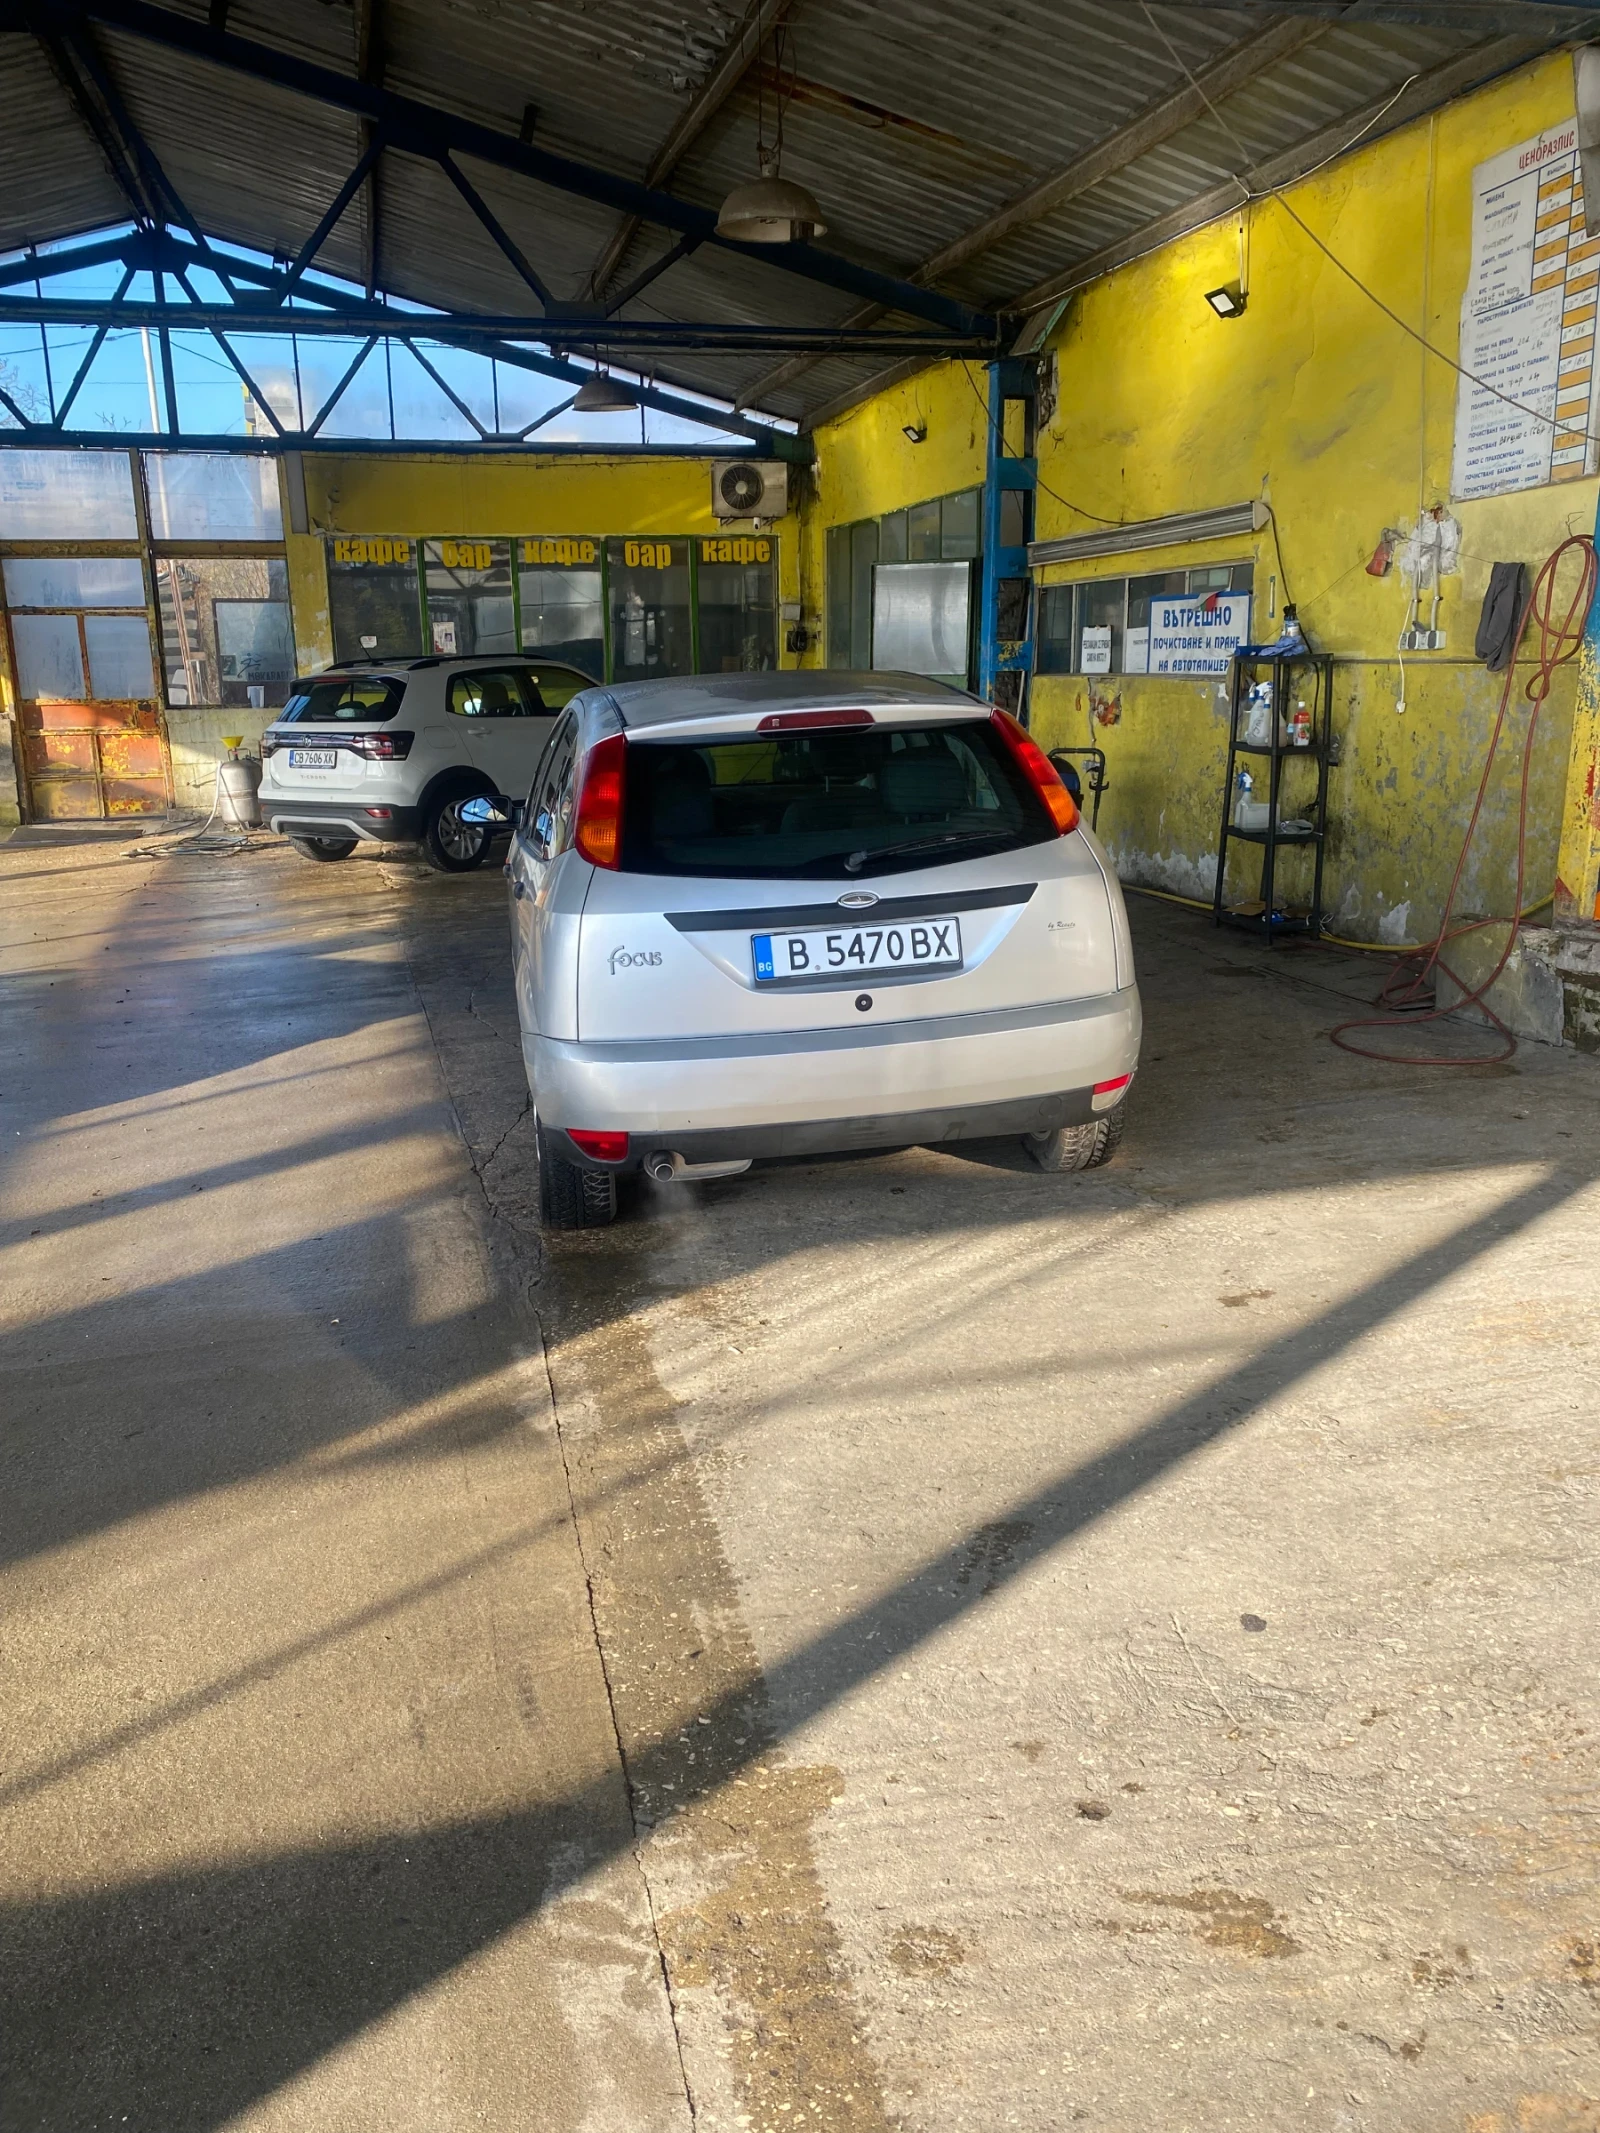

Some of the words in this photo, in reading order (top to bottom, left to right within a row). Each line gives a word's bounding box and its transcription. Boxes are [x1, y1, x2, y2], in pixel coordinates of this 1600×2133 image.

[1519, 131, 1575, 169] ЦЕНОРАЗПИС
[1469, 426, 1498, 440] ПОЧИСТВАНЕ
[1468, 440, 1497, 454] ПОЧИСТВАНЕ
[1465, 468, 1494, 482] ПОЧИСТВАНЕ
[334, 538, 410, 566] кафе
[442, 540, 491, 570] бар
[525, 539, 594, 566] кафе
[624, 540, 672, 570] бар
[702, 537, 770, 565] кафе
[1163, 605, 1232, 628] ВЪТРЕШНО
[1153, 636, 1203, 650] ПОЧИСТВАНЕ
[1205, 636, 1212, 649] И
[1214, 635, 1241, 649] ПРАНЕ
[1158, 660, 1169, 672] НА
[294, 752, 304, 764] CB
[304, 752, 323, 765] 7606
[323, 752, 334, 765] XK
[787, 938, 810, 971] B
[825, 929, 905, 967] 5470
[910, 925, 953, 960] BX
[757, 961, 773, 973] BG
